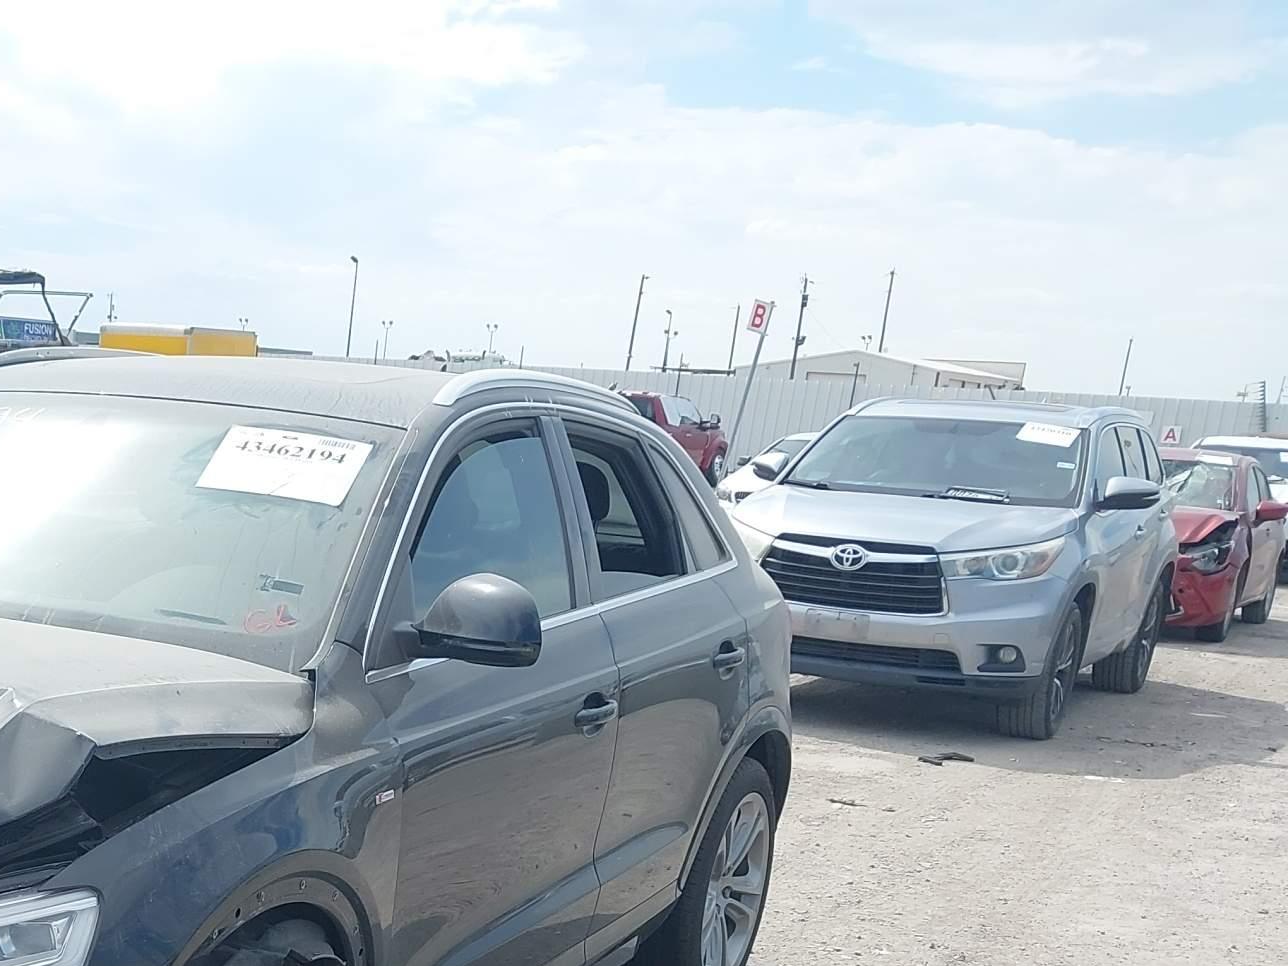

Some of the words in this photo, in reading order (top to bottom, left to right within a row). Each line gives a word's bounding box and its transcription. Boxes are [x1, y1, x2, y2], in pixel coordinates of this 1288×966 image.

[751, 303, 766, 328] B
[23, 322, 53, 336] FUSION
[1163, 427, 1177, 442] A
[235, 439, 348, 465] 43462194
